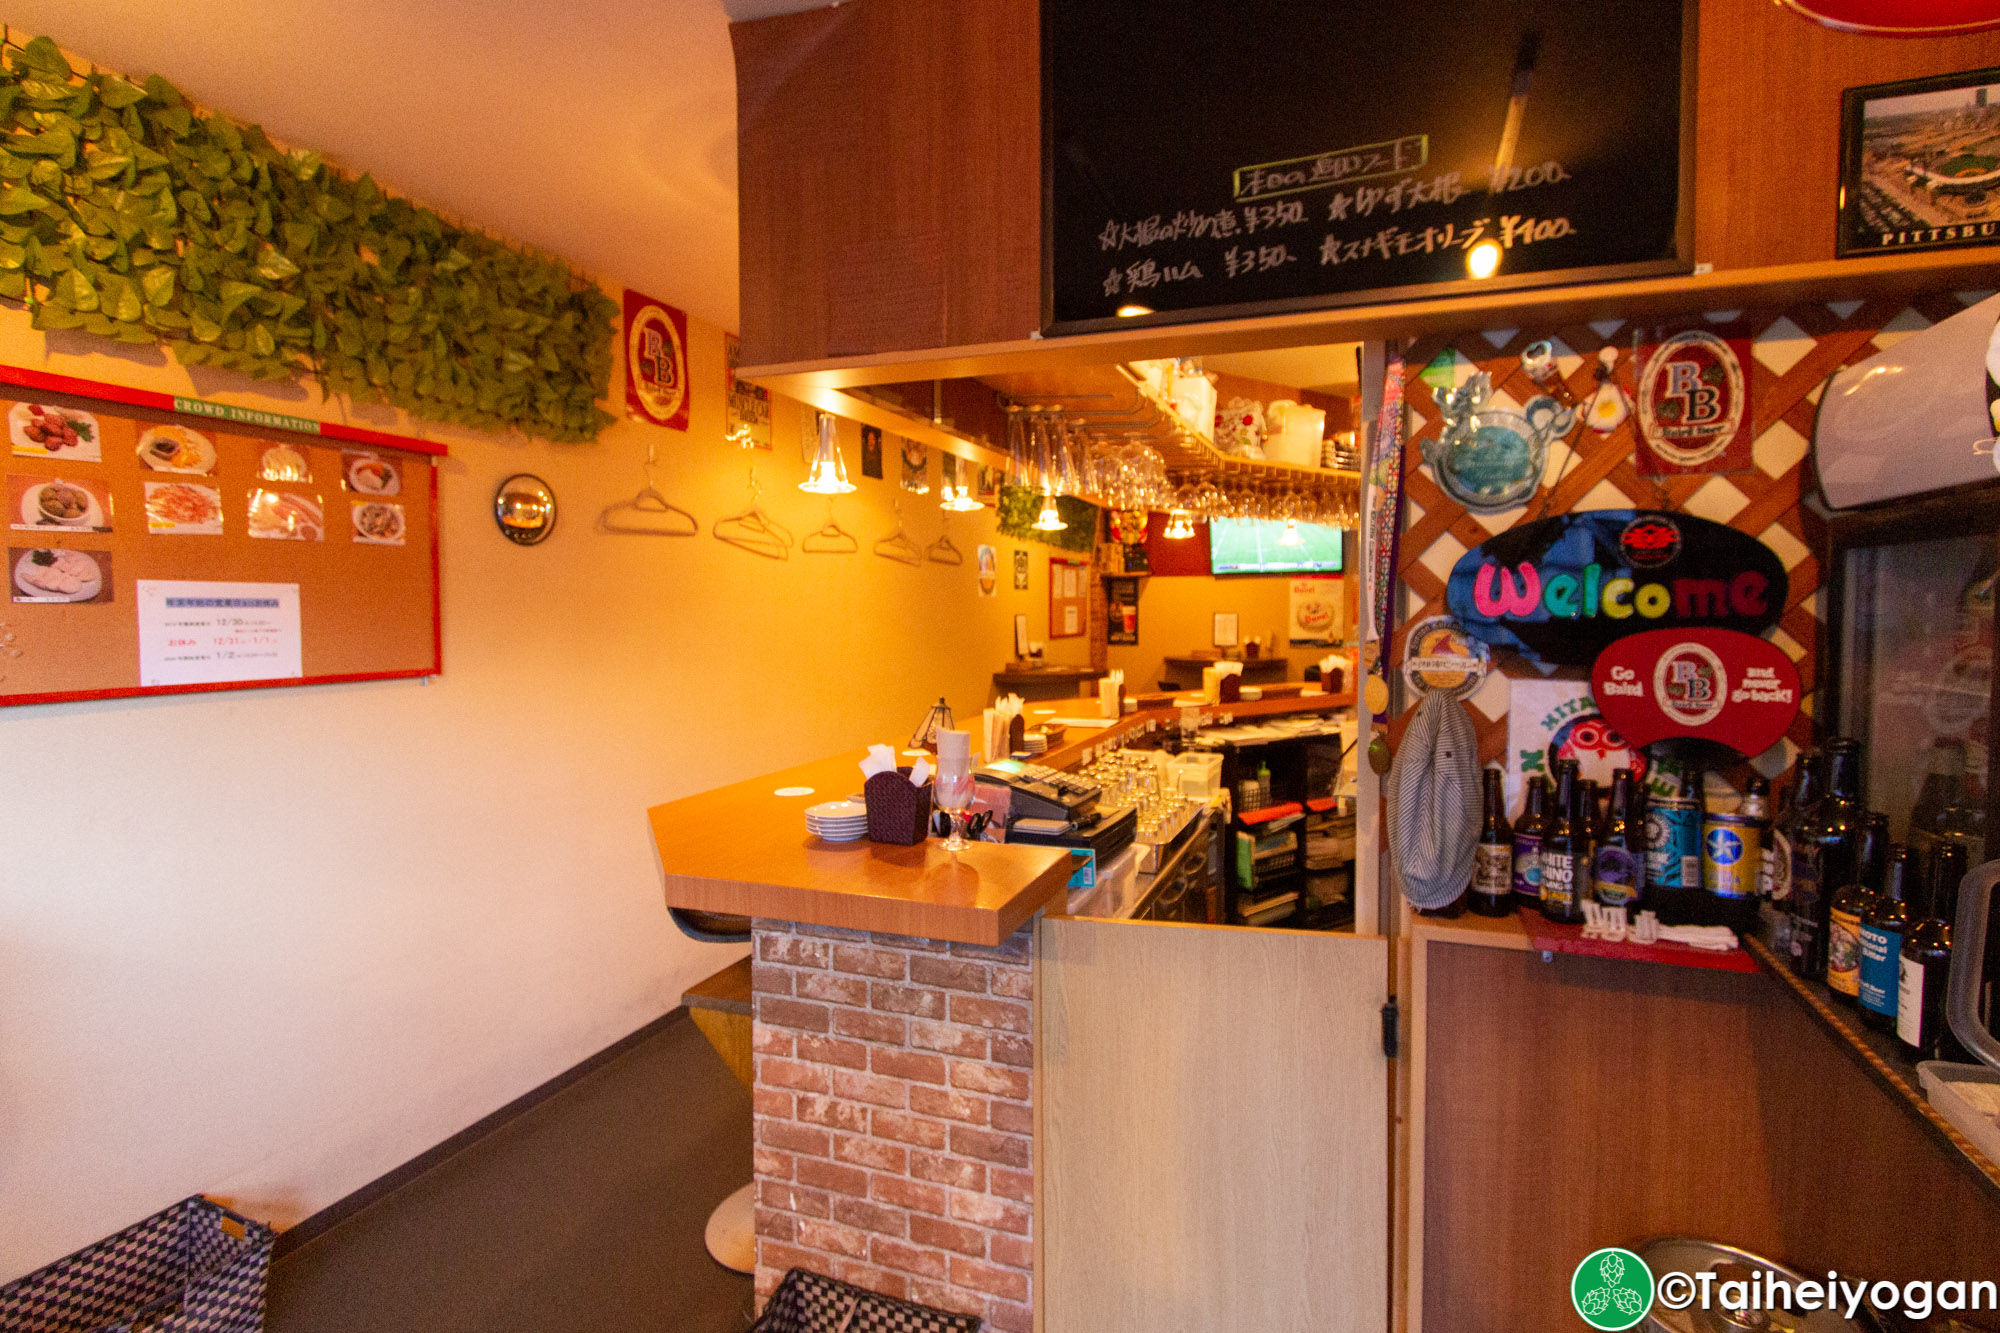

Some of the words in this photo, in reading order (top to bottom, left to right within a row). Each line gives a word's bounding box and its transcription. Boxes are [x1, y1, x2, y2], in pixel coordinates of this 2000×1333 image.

[174, 400, 225, 417] CROWD
[1474, 561, 1769, 619] Welcome
[1611, 665, 1635, 681] Go
[1604, 680, 1644, 697] Baird
